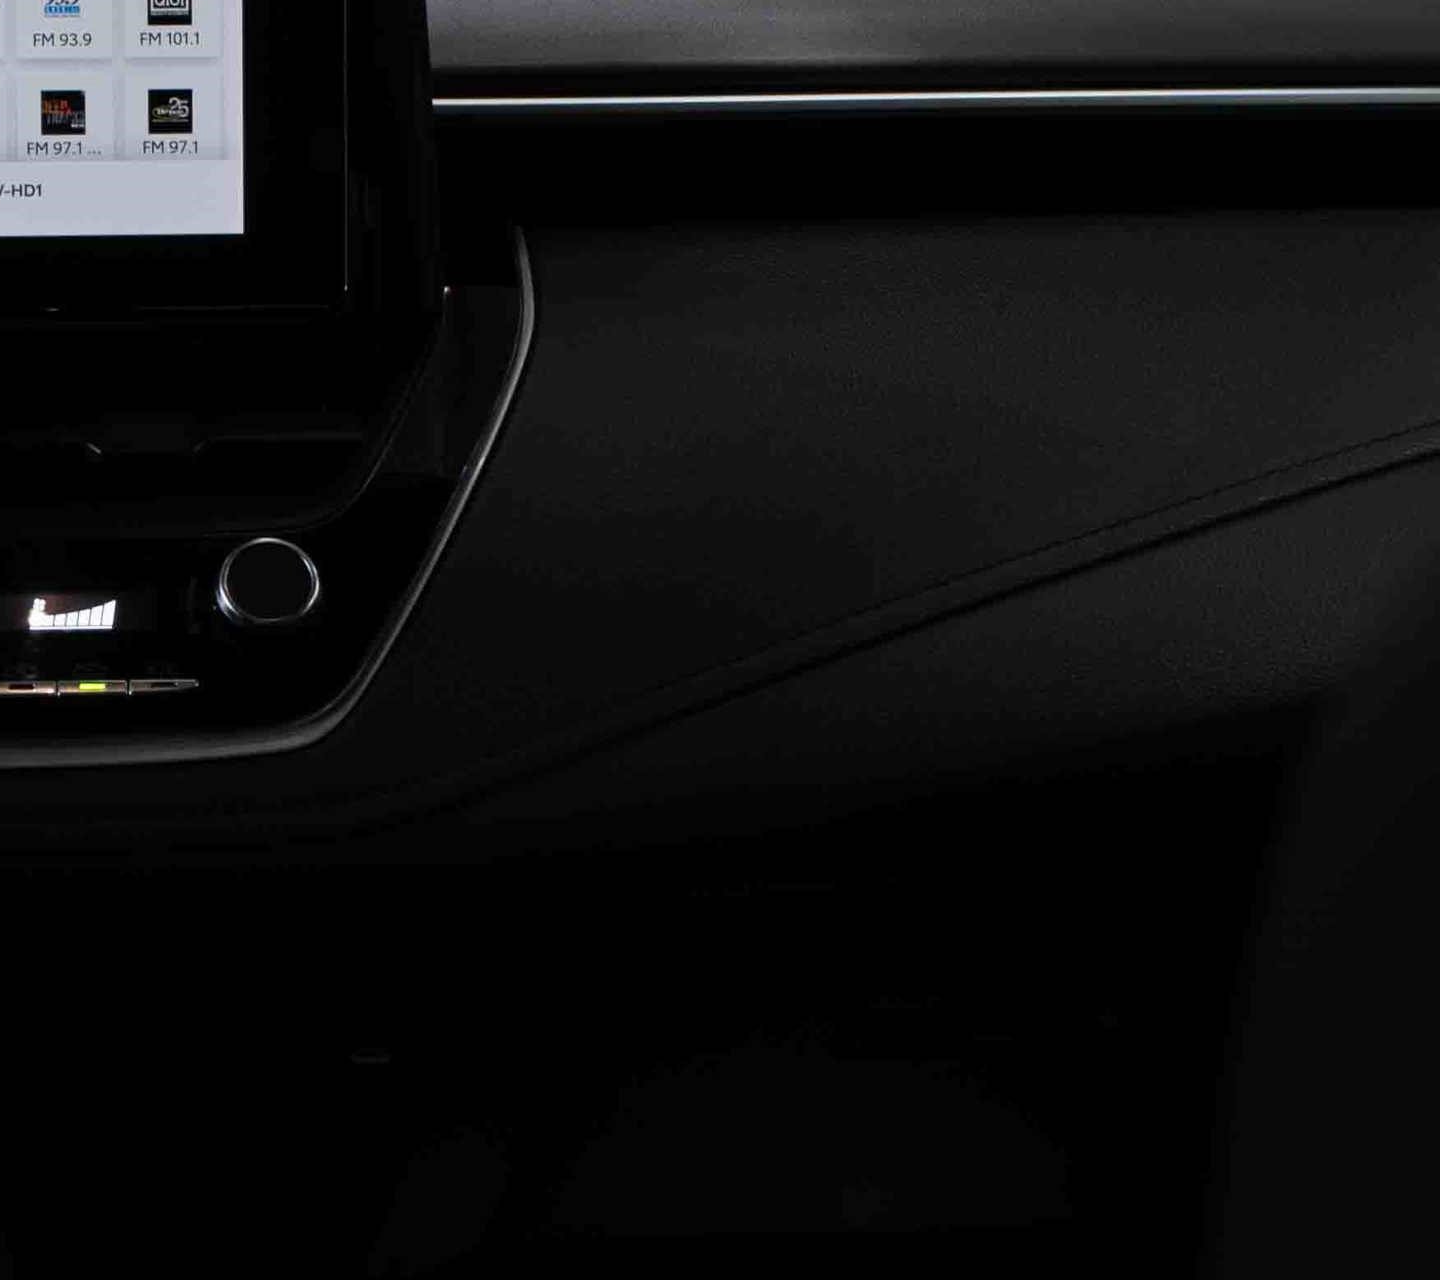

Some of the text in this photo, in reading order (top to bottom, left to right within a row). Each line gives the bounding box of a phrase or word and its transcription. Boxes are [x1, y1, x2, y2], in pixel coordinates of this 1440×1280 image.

[33, 32, 92, 48] FM 93.9
[139, 31, 201, 47] FM 101.1
[26, 141, 49, 156] FM
[52, 141, 84, 155] 97.1
[142, 140, 199, 155] FM 97.1
